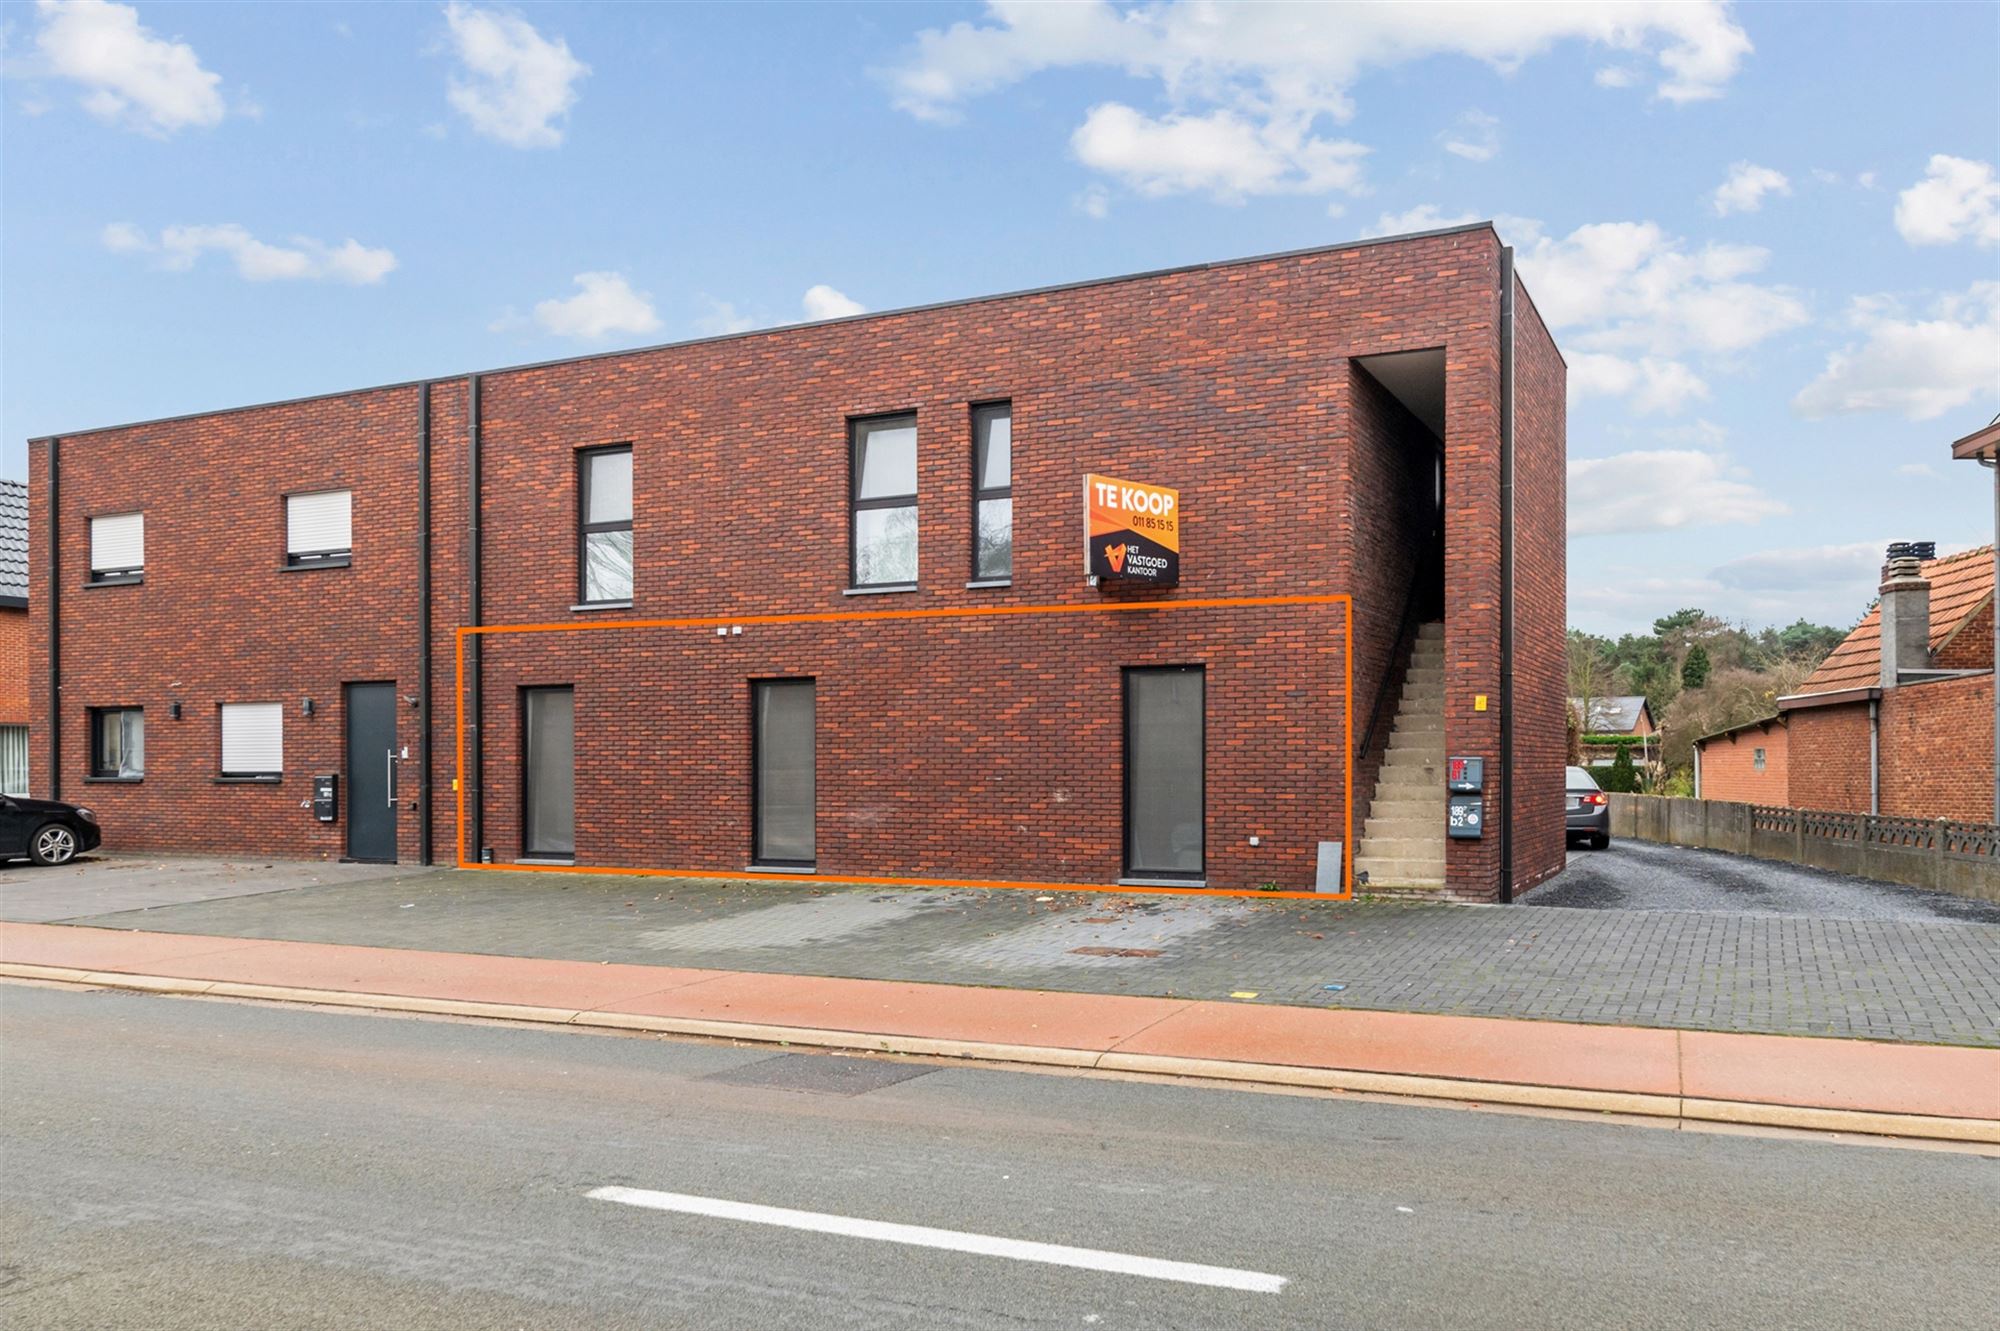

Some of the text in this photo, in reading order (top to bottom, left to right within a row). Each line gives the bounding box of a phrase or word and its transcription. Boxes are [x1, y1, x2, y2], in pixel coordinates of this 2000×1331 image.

[1095, 483, 1174, 517] TE KOOP
[1132, 515, 1174, 532] 011 85 15 15
[1127, 545, 1139, 554] HET
[1127, 554, 1168, 569] VASTGOED
[1127, 565, 1157, 577] KANTOOR
[1450, 815, 1464, 827] b2
